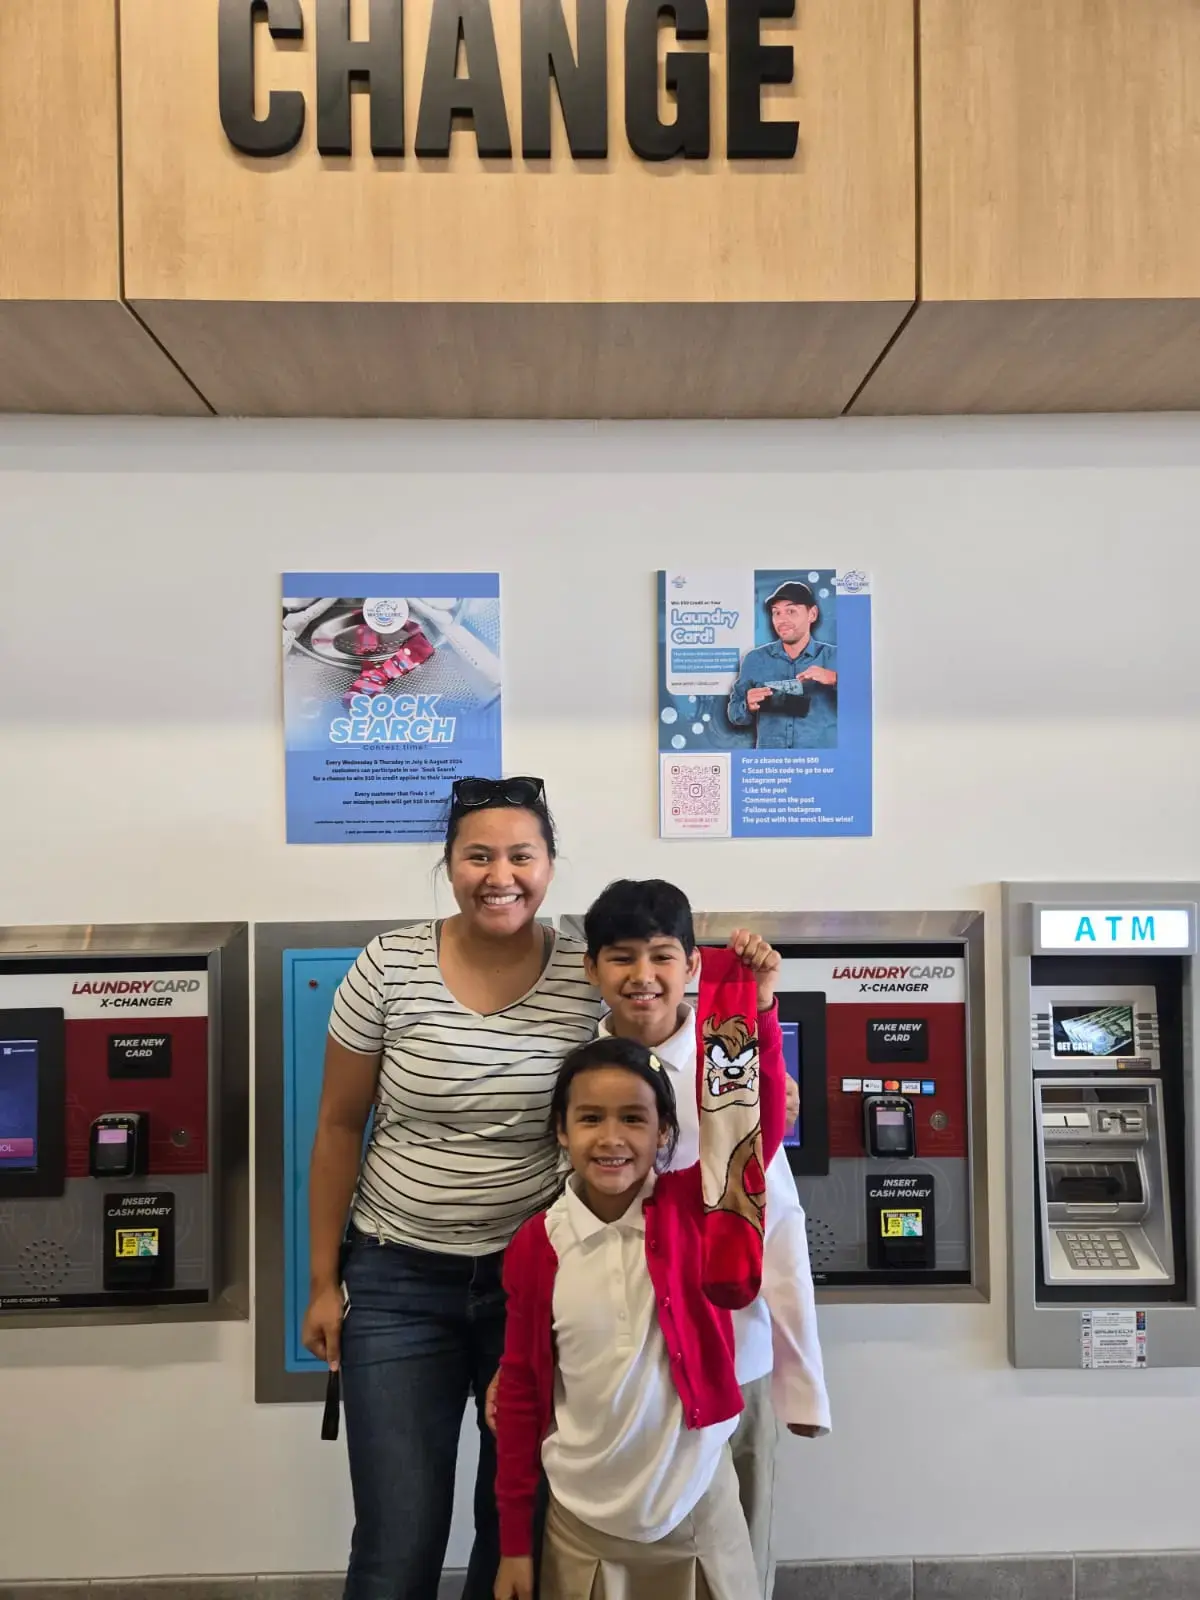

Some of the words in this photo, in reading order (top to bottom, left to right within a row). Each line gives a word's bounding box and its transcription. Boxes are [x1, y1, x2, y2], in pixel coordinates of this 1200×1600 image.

[218, 0, 800, 160] CHANGE
[671, 607, 739, 629] Laundry
[671, 627, 715, 645] Card!
[350, 694, 441, 718] SOCK
[329, 717, 456, 743] SEARCH
[772, 787, 787, 795] post
[800, 797, 815, 805] post
[1075, 916, 1155, 942] ATM
[832, 966, 955, 979] LAUNDRYCARD
[72, 980, 200, 995] LAUNDRYCARD
[859, 983, 929, 993] X-CHANGER
[100, 997, 173, 1008] X-CHANGER
[872, 1023, 898, 1032] TAKE
[898, 1023, 922, 1032] NEW
[113, 1039, 140, 1048] TAKE
[140, 1038, 166, 1047] NEW
[883, 1034, 910, 1042] CARD
[1057, 1042, 1071, 1051] GET
[1072, 1041, 1093, 1051] CASH
[125, 1049, 153, 1058] CARD
[883, 1179, 918, 1187] INSERT
[869, 1189, 896, 1197] CASH
[897, 1189, 931, 1197] MONEY
[122, 1197, 158, 1206] INSERT
[107, 1208, 135, 1217] CASH
[136, 1207, 172, 1216] MONEY
